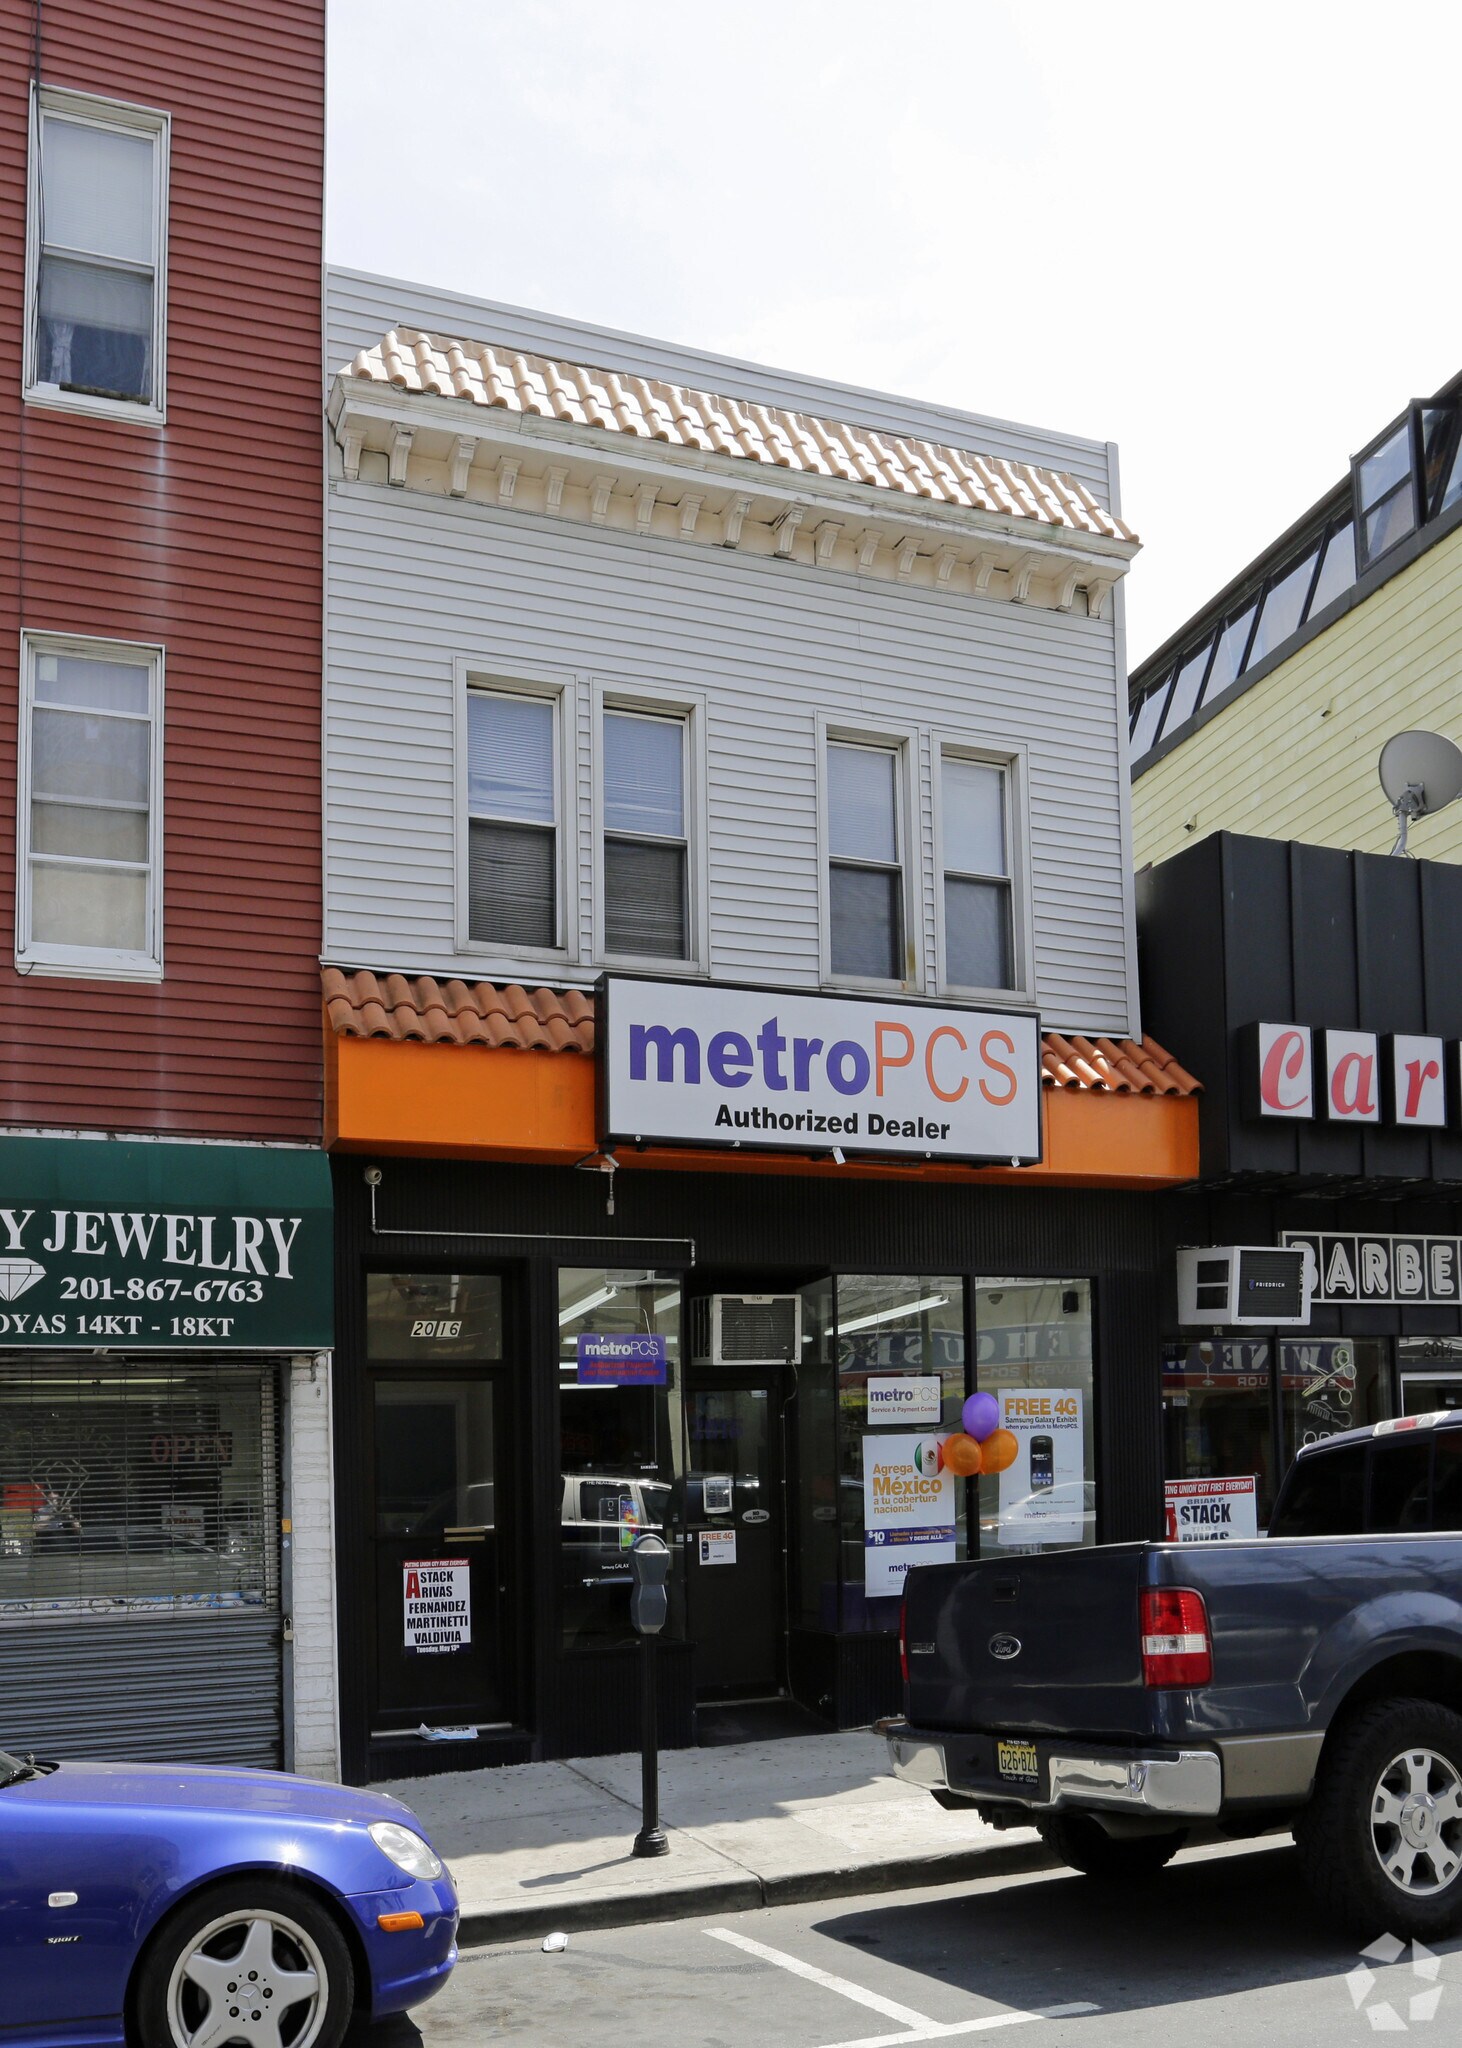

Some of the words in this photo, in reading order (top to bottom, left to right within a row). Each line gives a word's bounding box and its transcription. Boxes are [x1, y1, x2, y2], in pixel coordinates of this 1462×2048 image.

[629, 1016, 1018, 1106] metroPCS
[1261, 1031, 1439, 1118] Car
[715, 1104, 859, 1135] Authorized
[867, 1113, 951, 1140] Dealer
[43, 1209, 302, 1281] JEWELRY
[60, 1276, 264, 1303] 201-867-6763
[76, 1315, 142, 1335] 14KT
[170, 1317, 234, 1337] 18KT
[413, 1322, 460, 1336] 2016
[585, 1341, 660, 1356] metroPCS
[870, 1387, 939, 1401] metroPCS
[1004, 1398, 1051, 1416] FREE
[1054, 1397, 1078, 1416] 4G
[1035, 1416, 1055, 1424] Galaxy
[873, 1464, 913, 1476] Agrega
[872, 1476, 943, 1496] México
[1165, 1485, 1178, 1495] TING
[1179, 1484, 1197, 1494] UNION
[1198, 1483, 1210, 1493] CITY
[1210, 1482, 1225, 1492] FIRST
[1225, 1480, 1253, 1491] EVERYDAY!
[881, 1496, 891, 1505] tu
[892, 1495, 937, 1504] cobertura
[874, 1504, 915, 1514] nacional.
[1180, 1503, 1232, 1526] STACK
[868, 1531, 885, 1542] $10
[420, 1571, 454, 1583] STACK
[422, 1586, 453, 1598] RIVAS
[409, 1600, 466, 1614] FERNANDEZ
[407, 1615, 468, 1629] MARTINETTI
[414, 1631, 461, 1644] VALDIVIA
